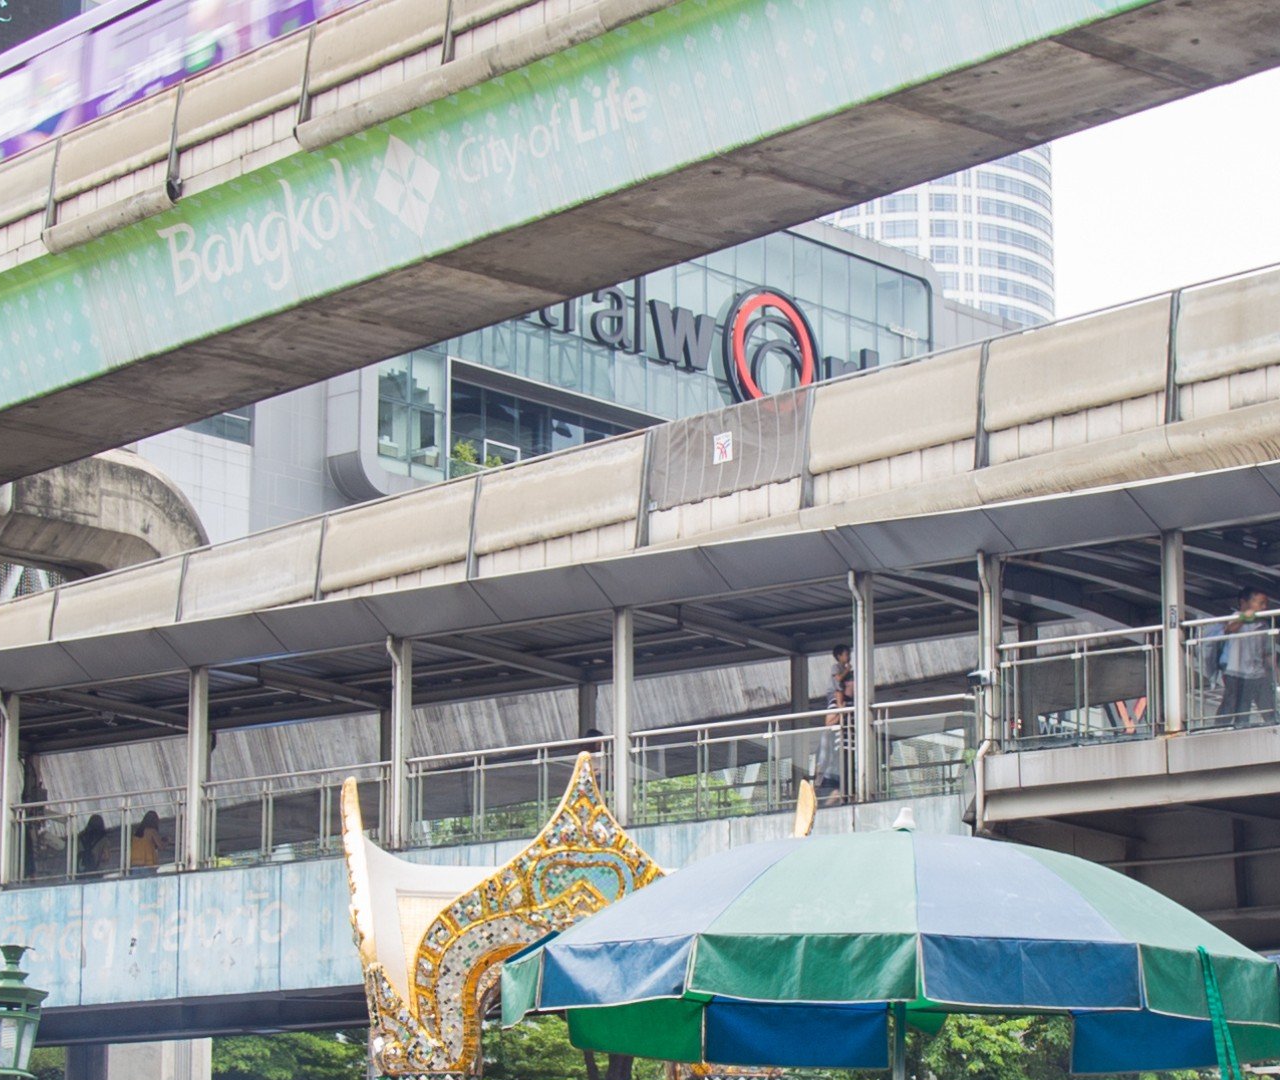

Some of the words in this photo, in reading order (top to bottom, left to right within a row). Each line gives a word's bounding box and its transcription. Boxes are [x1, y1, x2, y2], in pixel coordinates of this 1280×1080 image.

[157, 157, 375, 297] Bangkok
[456, 127, 519, 184] City
[527, 114, 563, 160] of
[567, 76, 652, 143] Life
